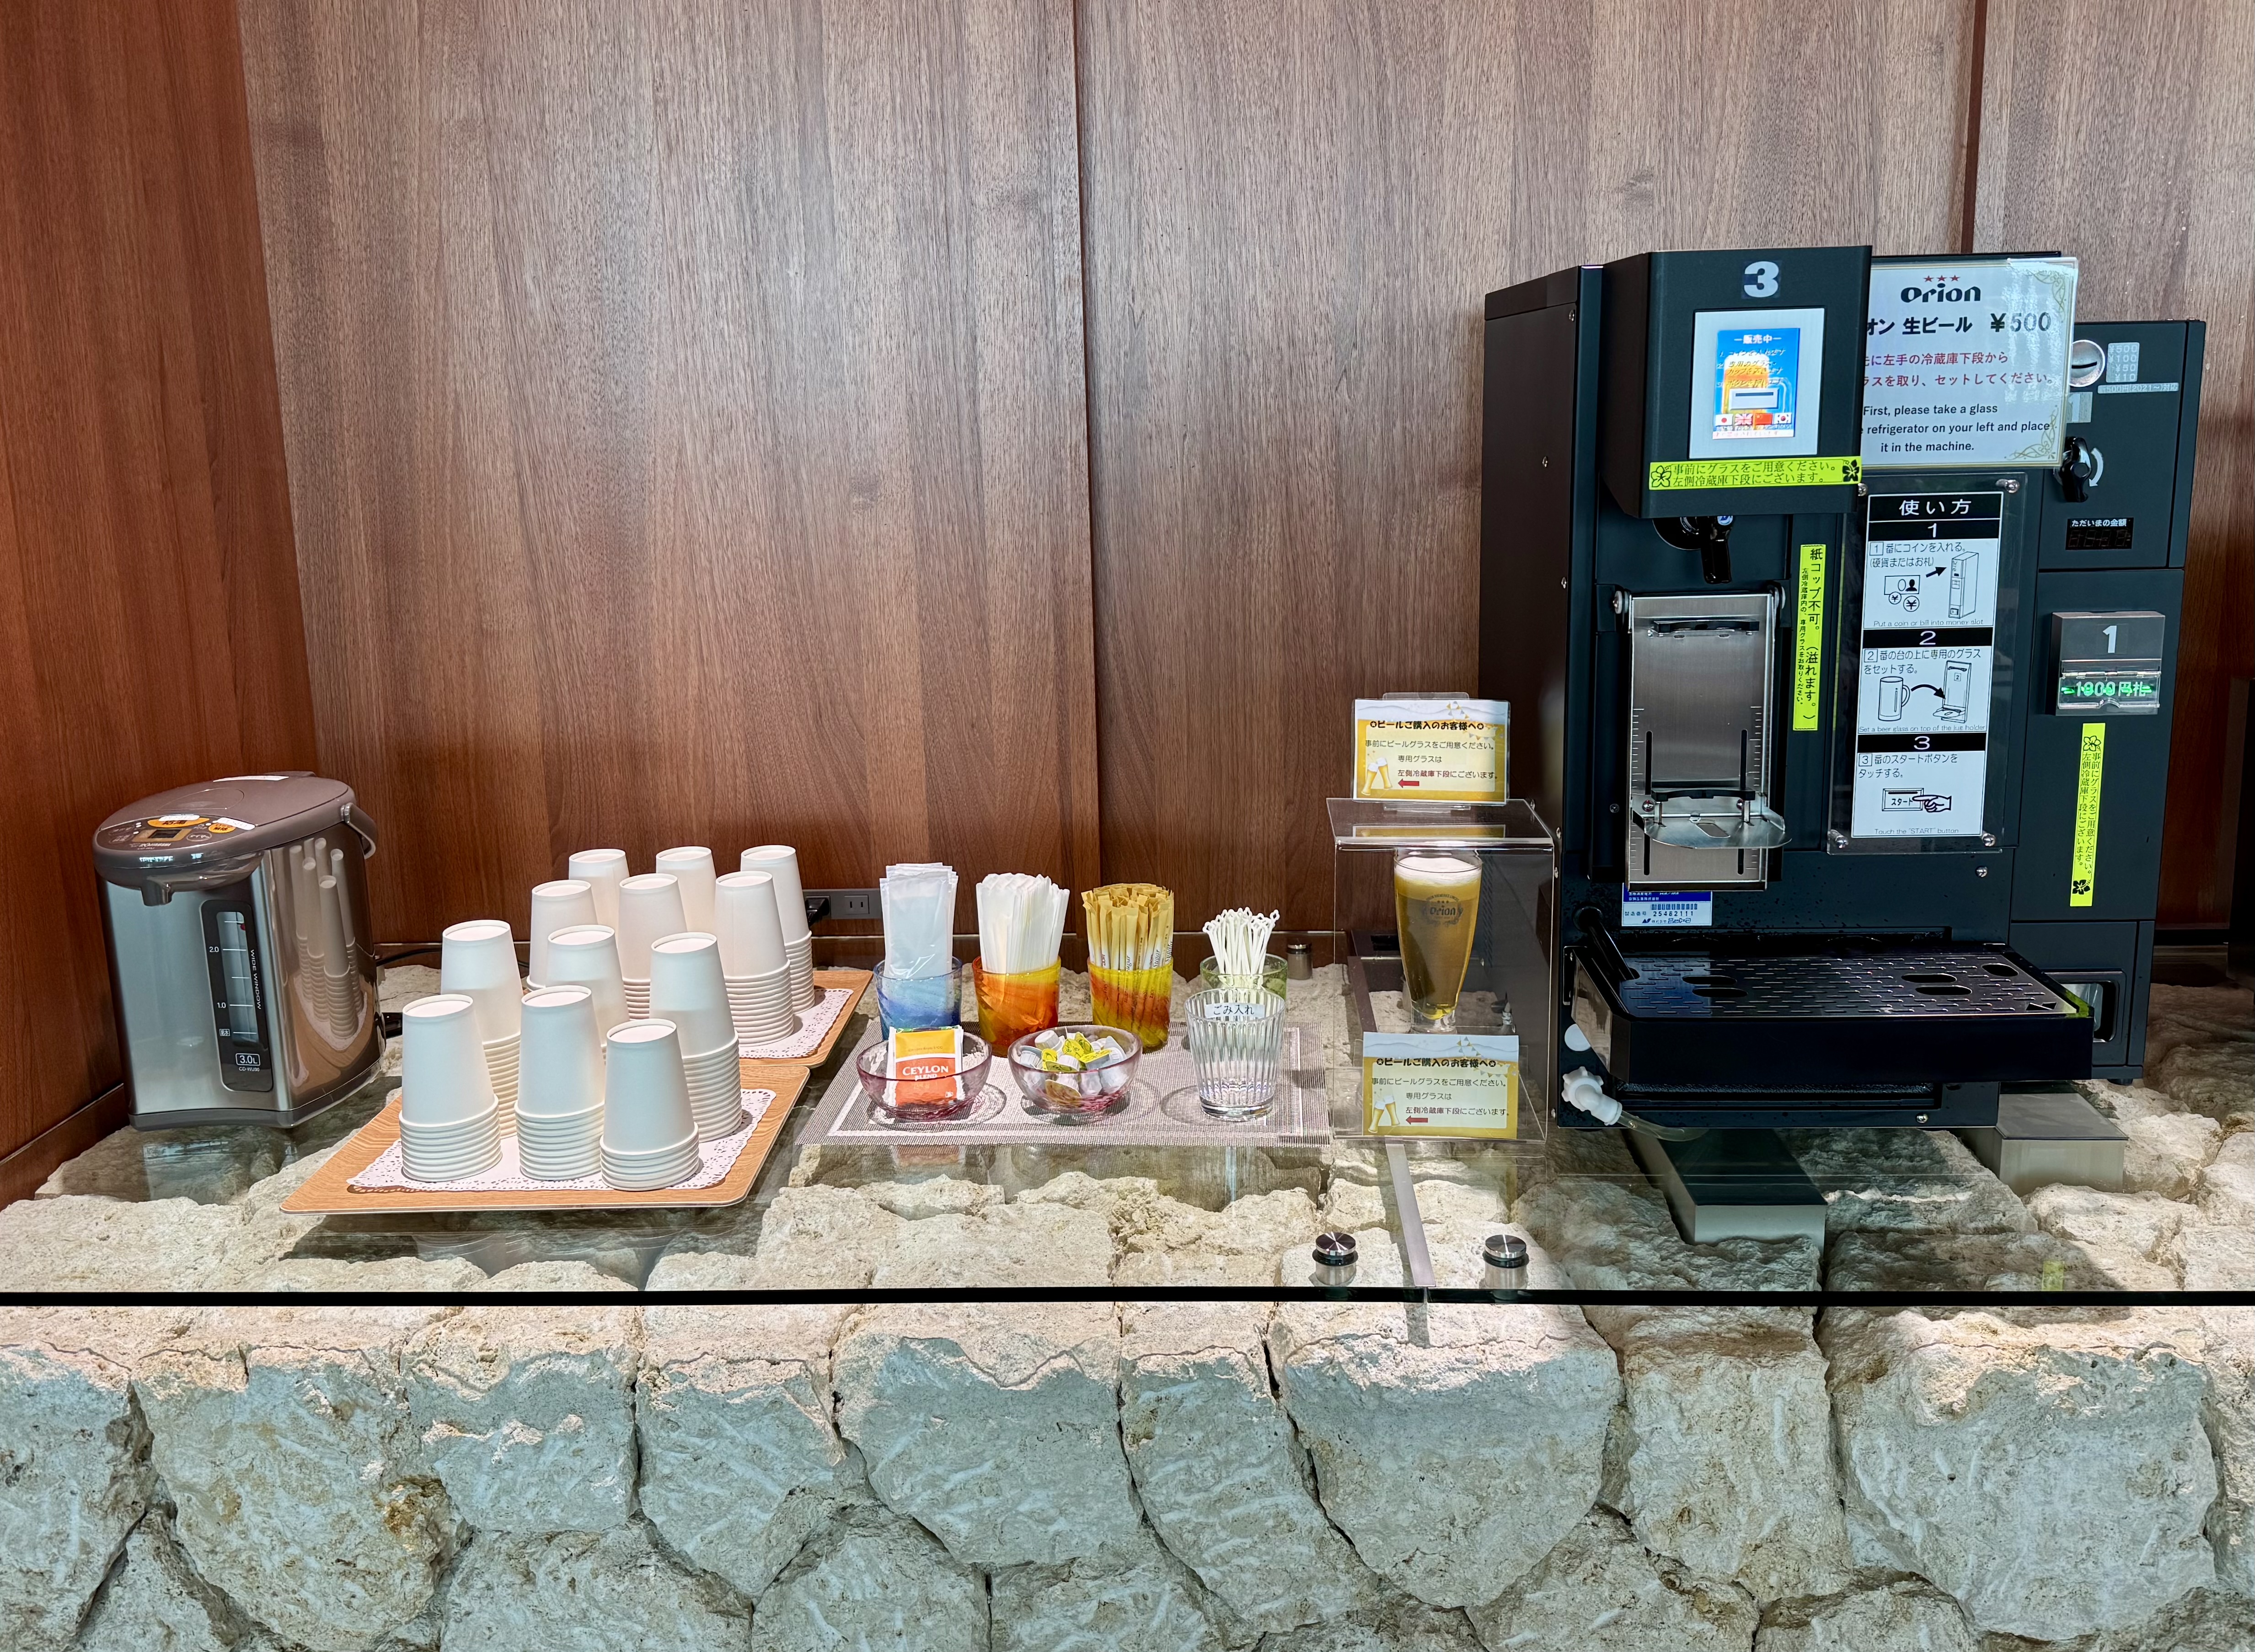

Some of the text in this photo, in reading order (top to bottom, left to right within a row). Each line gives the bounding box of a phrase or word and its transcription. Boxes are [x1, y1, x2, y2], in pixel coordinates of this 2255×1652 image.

[1744, 261, 1779, 298] 3
[1902, 316, 1973, 334] 生ビール
[1863, 406, 1891, 417] First,
[1894, 406, 1929, 417] please
[1934, 404, 1956, 414] take
[1970, 404, 1998, 415] glass
[1867, 424, 1928, 435] refrigerator
[1949, 424, 1973, 434] your
[1976, 422, 1994, 431] left
[1998, 422, 2018, 431] and
[2021, 421, 2050, 432] place
[1881, 441, 1974, 452] it in the machine.
[1673, 461, 1835, 475] 事前にグラスをご用意ください。
[1899, 499, 1971, 515] 使い方
[1928, 523, 1937, 538] 1
[1919, 630, 1936, 645] 2
[2103, 625, 2117, 653] 1
[1864, 664, 1918, 675] をセットする。
[1365, 740, 1494, 750] 事前にビールグラスをご用意ください。
[1913, 736, 1930, 750] 3
[1398, 769, 1498, 779] 左側冷蔵庫下段にございます。
[1859, 768, 1903, 778] タッチする。
[1891, 798, 1913, 806] スタート
[1152, 949, 1161, 967] Sugar
[1214, 1004, 1254, 1015] ごみ入れ
[239, 1055, 257, 1064] 3.0L
[902, 1065, 949, 1076] CEYLON
[1372, 1078, 1506, 1087] 事前にビールグラスをご用意ください。
[1405, 1107, 1510, 1116] 左側冷蔵庫下段にございます。
